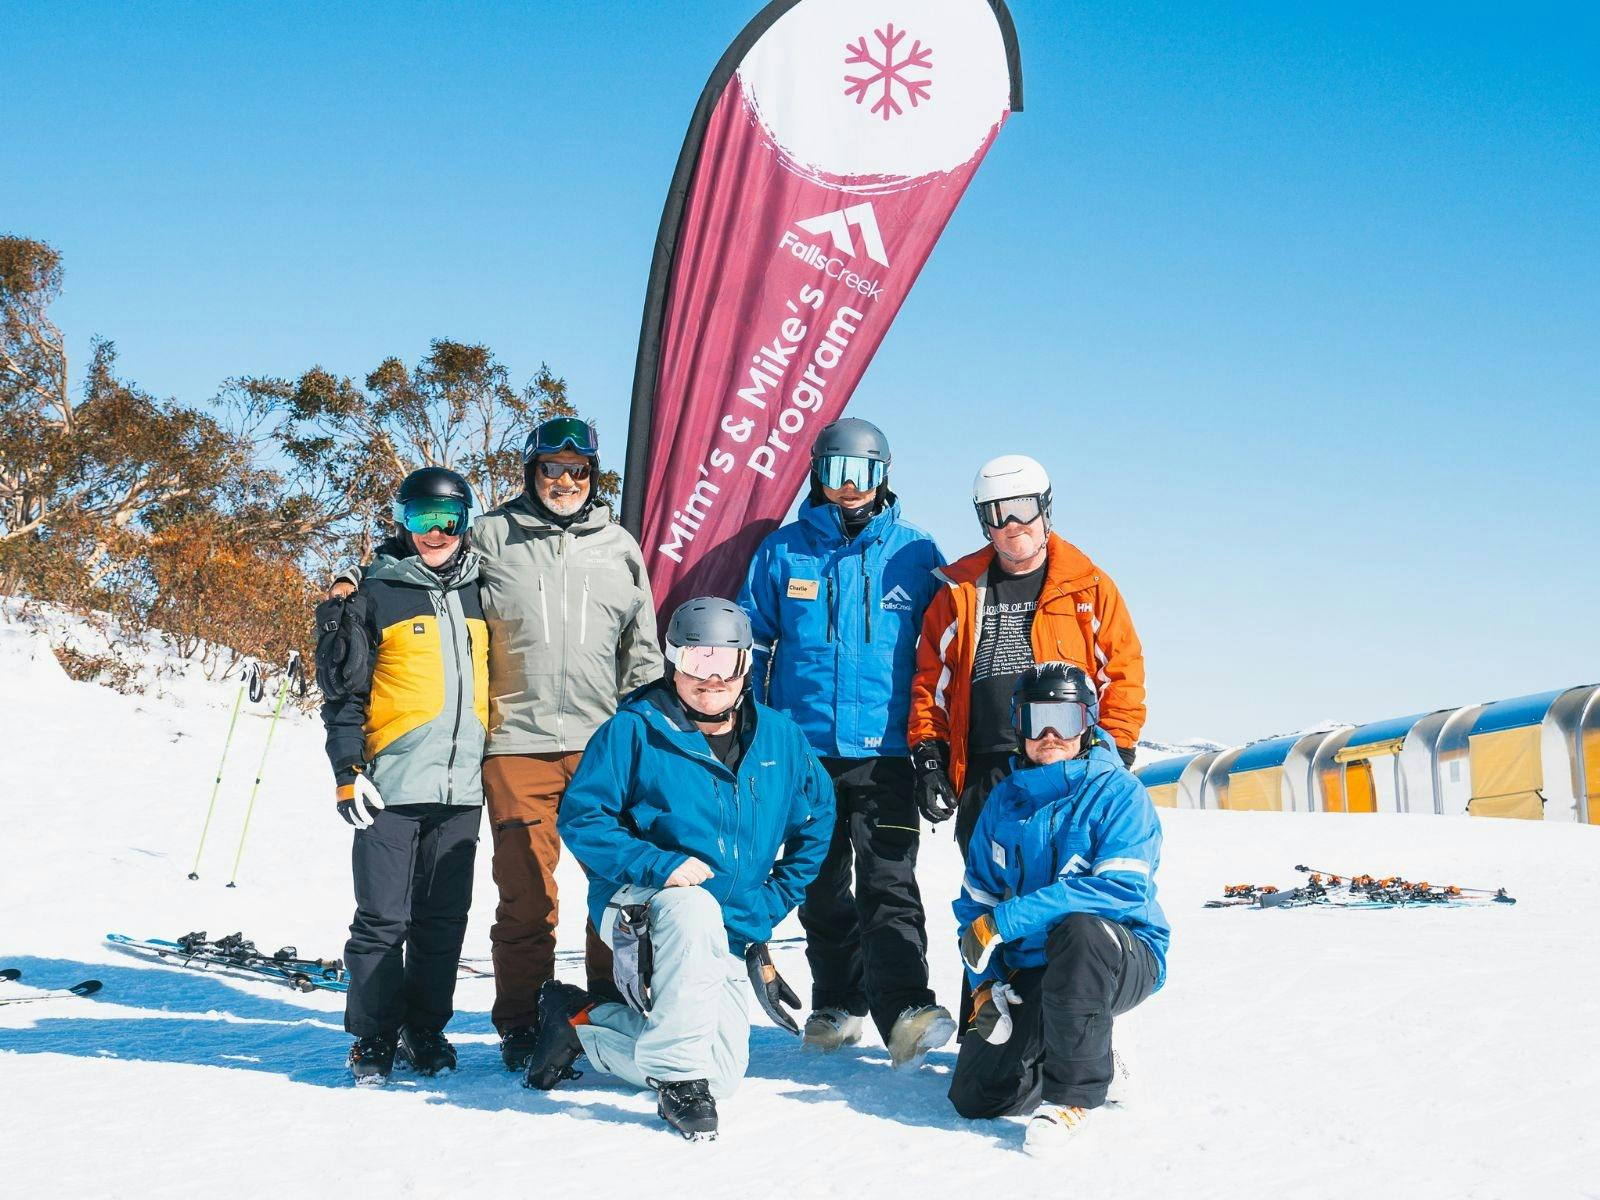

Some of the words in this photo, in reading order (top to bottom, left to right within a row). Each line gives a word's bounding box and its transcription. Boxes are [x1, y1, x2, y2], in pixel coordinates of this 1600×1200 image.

[778, 230, 884, 302] FallsCreek
[736, 284, 825, 410] Mike's
[746, 306, 864, 480] Program
[720, 414, 757, 443] &
[658, 447, 735, 564] Mim's
[1077, 603, 1092, 612] HH
